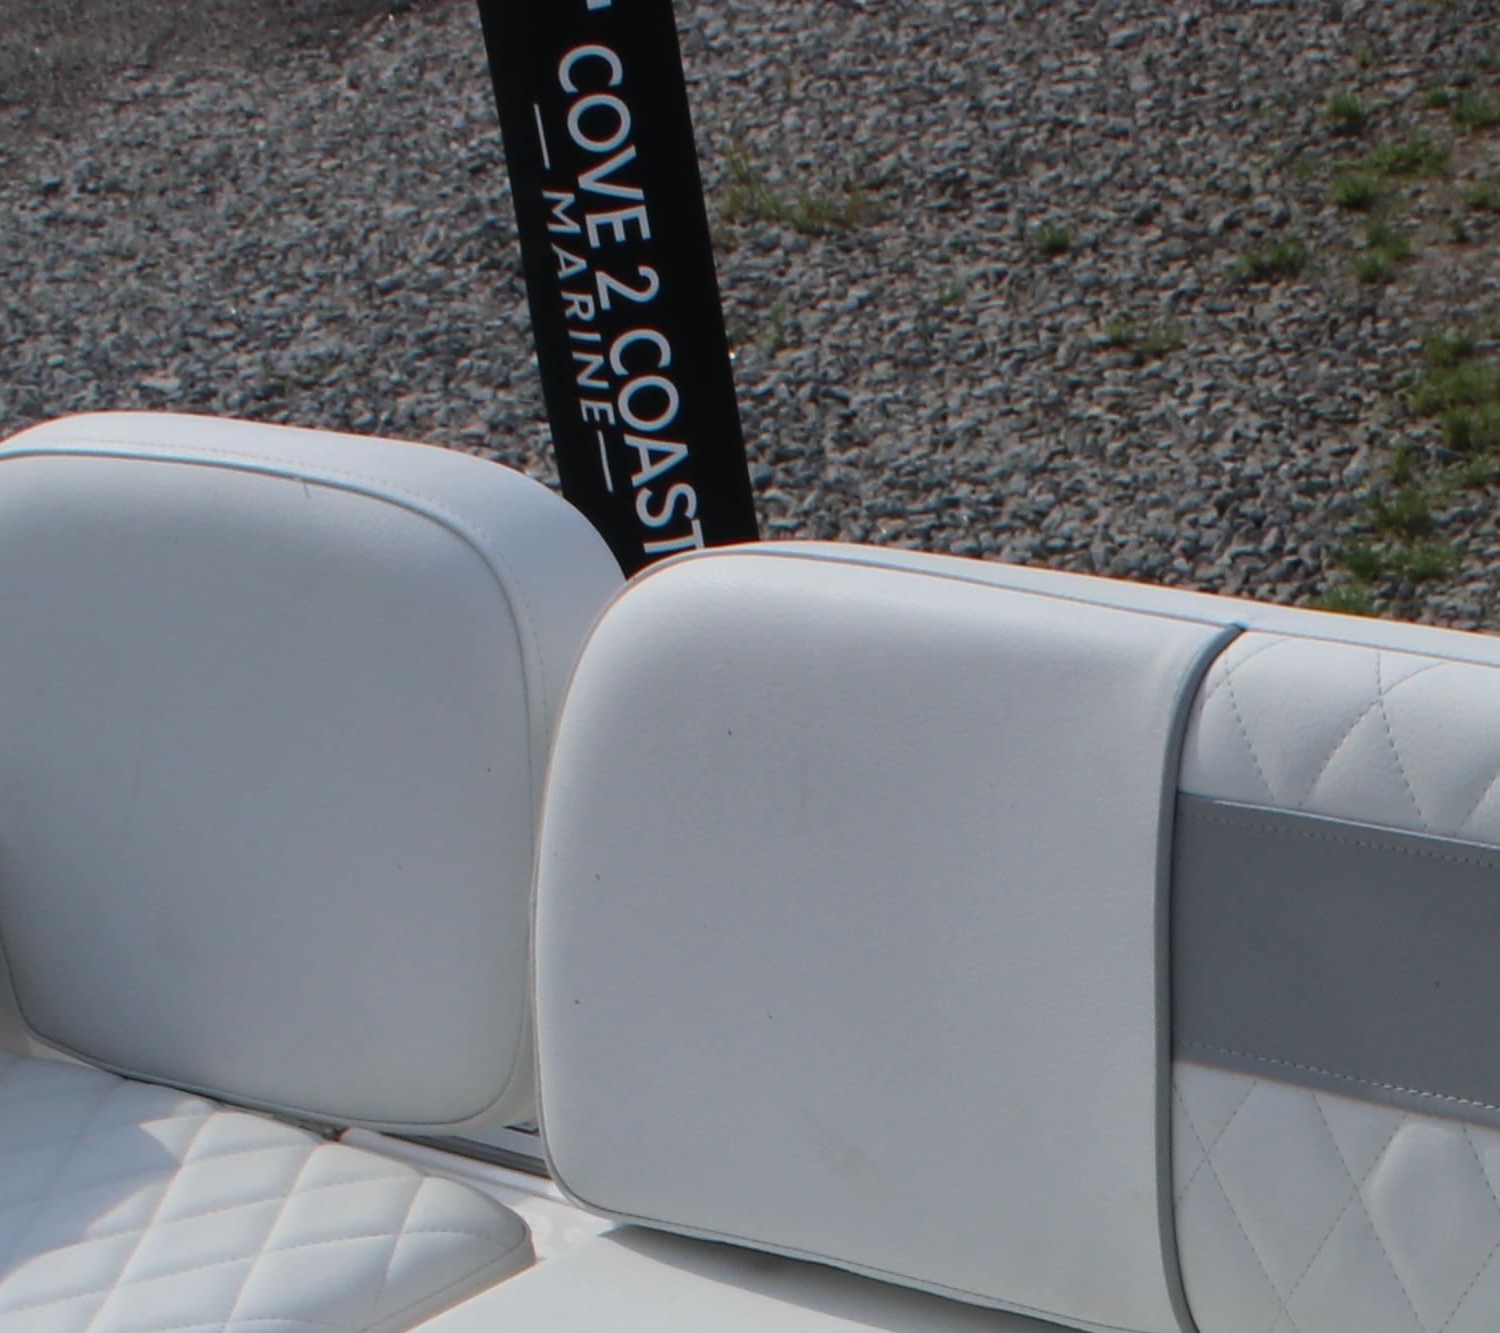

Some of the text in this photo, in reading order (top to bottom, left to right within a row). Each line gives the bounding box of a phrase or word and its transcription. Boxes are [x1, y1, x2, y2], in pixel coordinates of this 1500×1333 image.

[541, 189, 617, 426] MARINE
[557, 44, 705, 554] COVE 2 COAST
